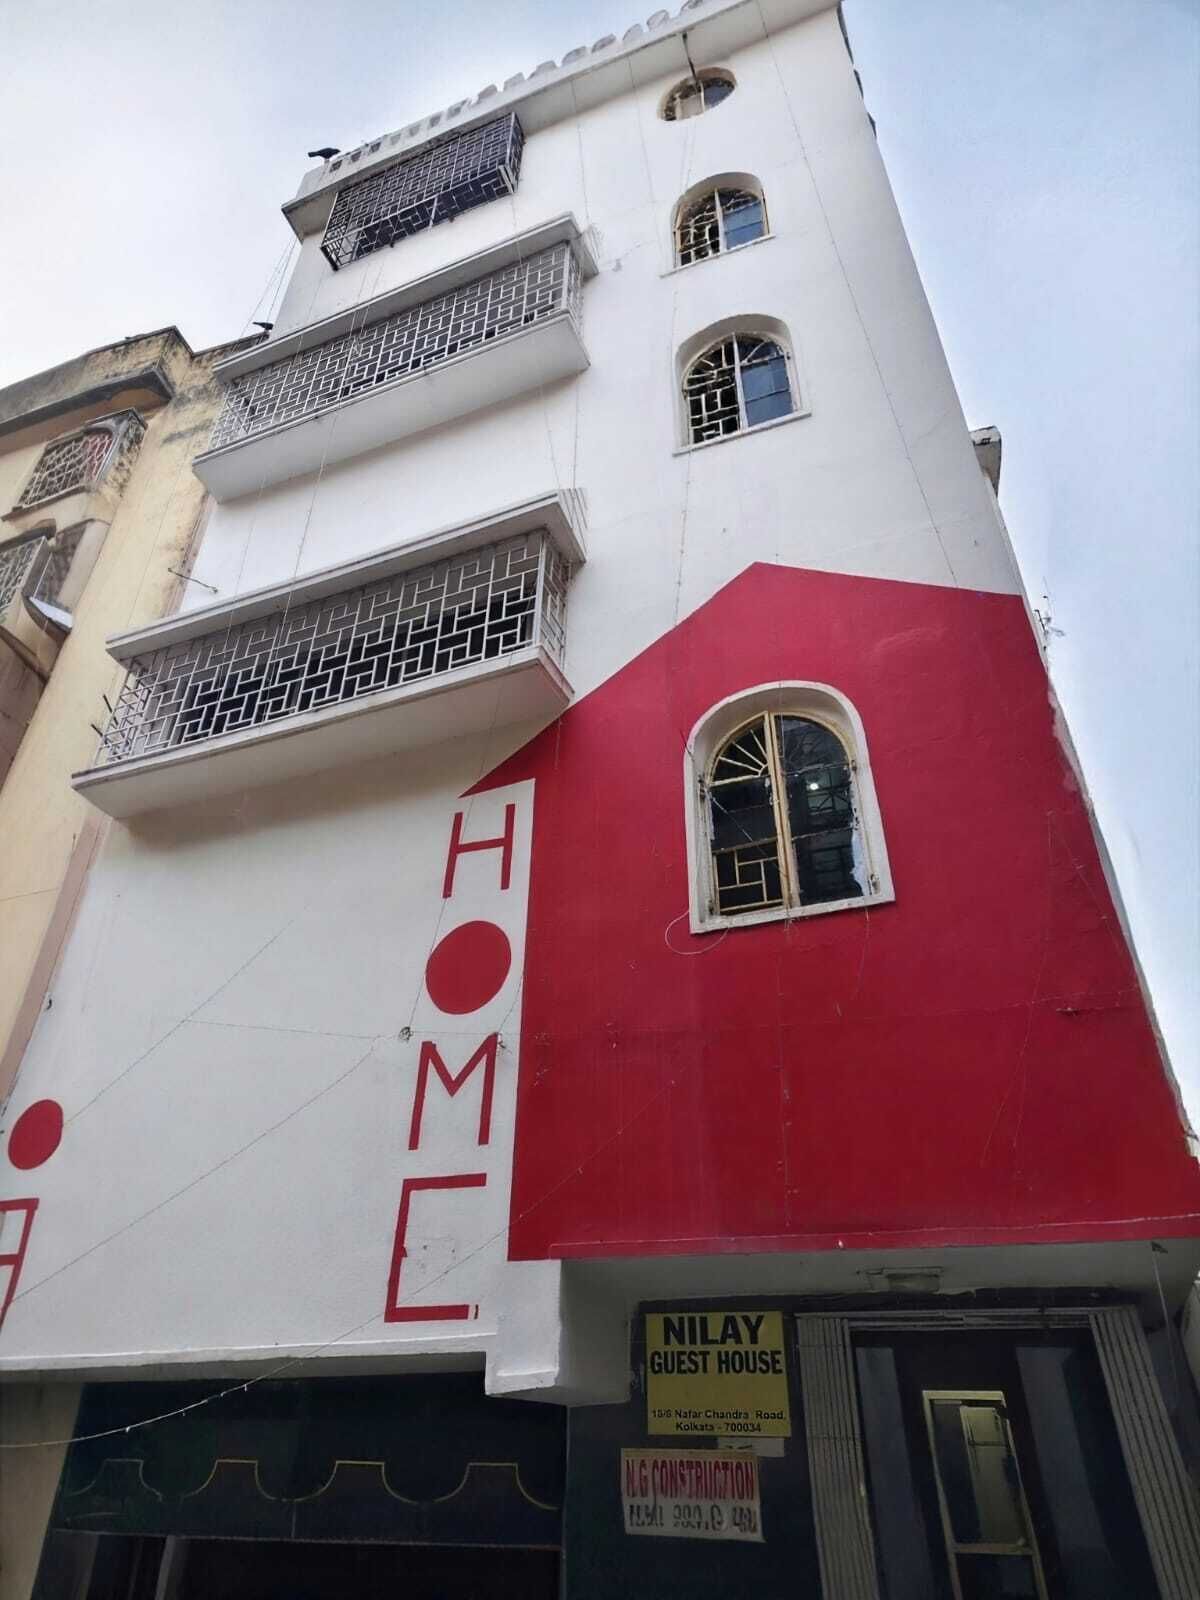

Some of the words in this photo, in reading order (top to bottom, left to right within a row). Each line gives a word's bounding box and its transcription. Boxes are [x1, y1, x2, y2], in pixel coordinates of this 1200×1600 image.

[663, 1314, 765, 1346] NILAY
[650, 1351, 710, 1375] GUEST
[717, 1350, 783, 1375] HOUSE
[675, 1421, 714, 1433] Kolkata
[724, 1421, 762, 1433] 700034
[704, 1409, 749, 1420] Chandra
[650, 1460, 755, 1502] CONSTRUCTION
